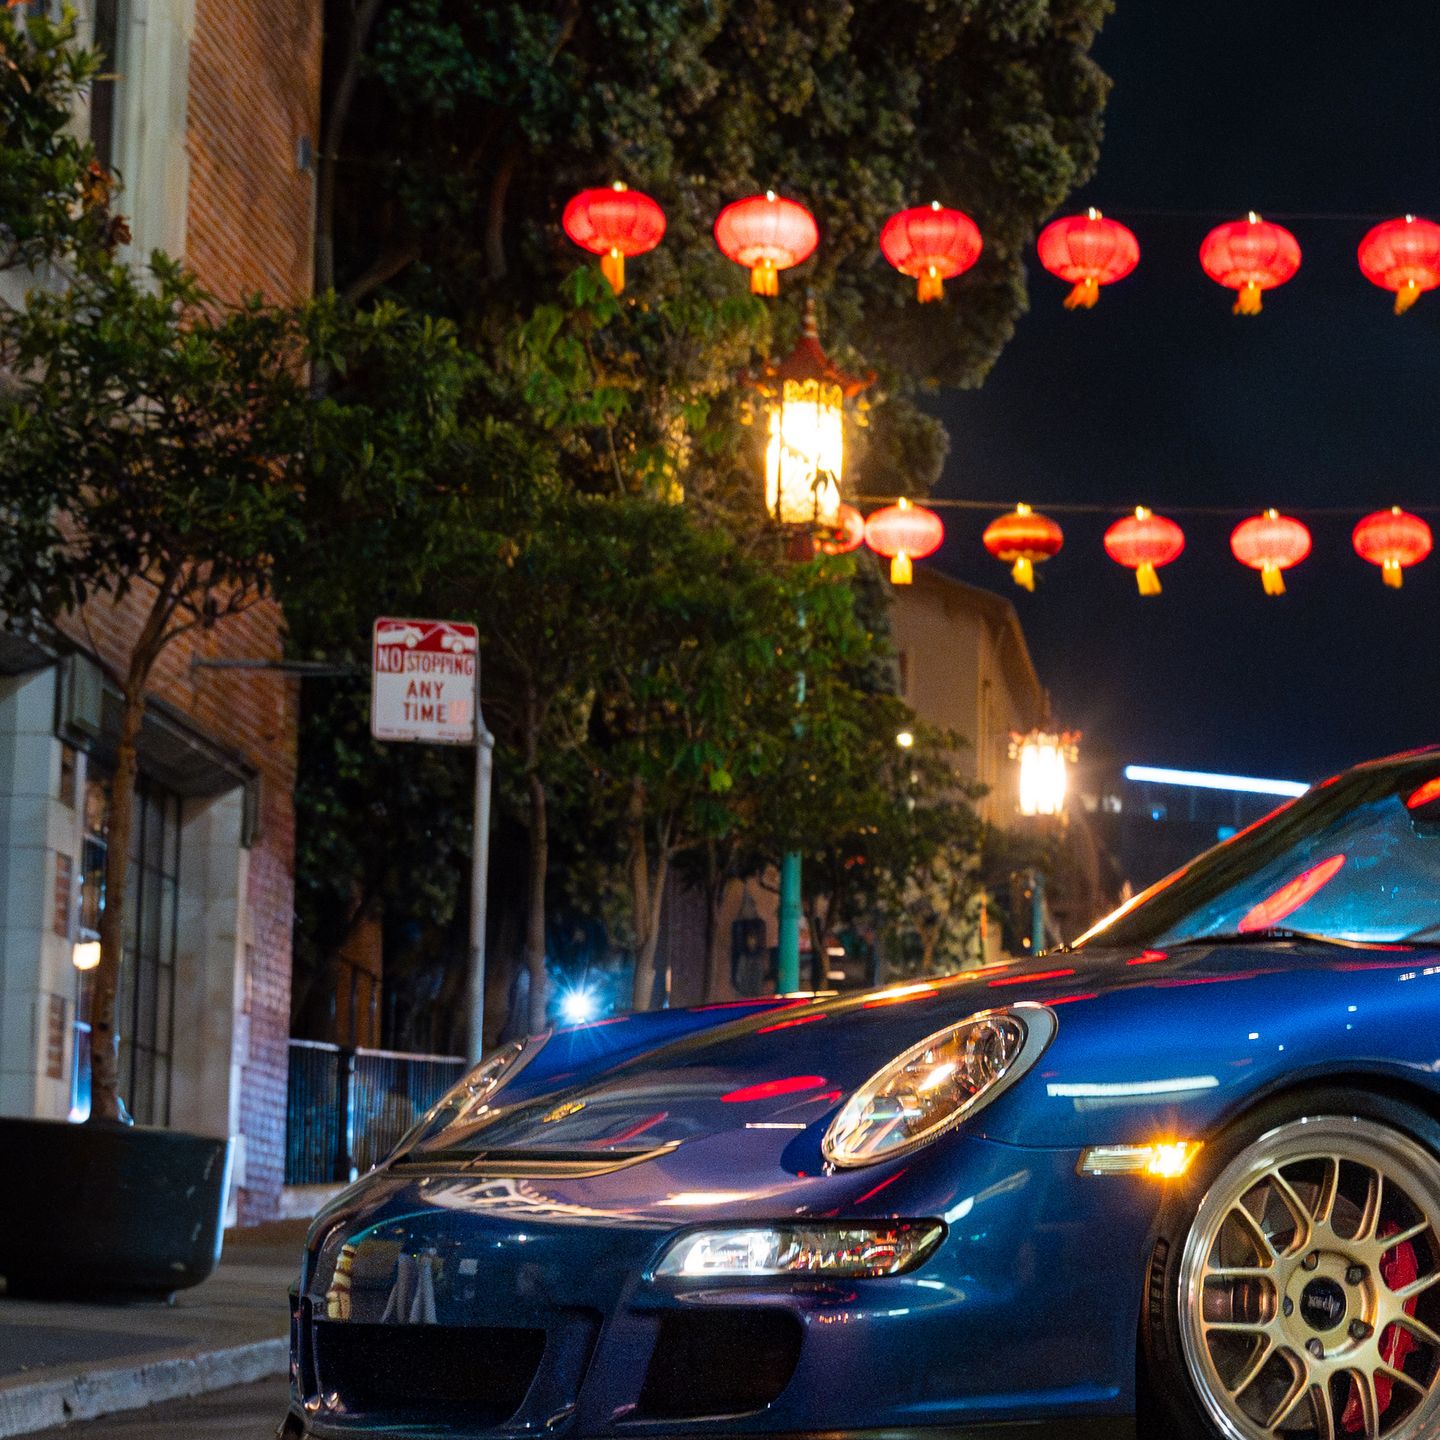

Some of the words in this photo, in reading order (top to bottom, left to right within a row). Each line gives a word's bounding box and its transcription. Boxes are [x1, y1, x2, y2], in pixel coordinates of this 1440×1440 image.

[377, 646, 402, 672] NO
[407, 653, 473, 675] STOPPING
[406, 679, 445, 699] ANY
[403, 702, 447, 723] TIME
